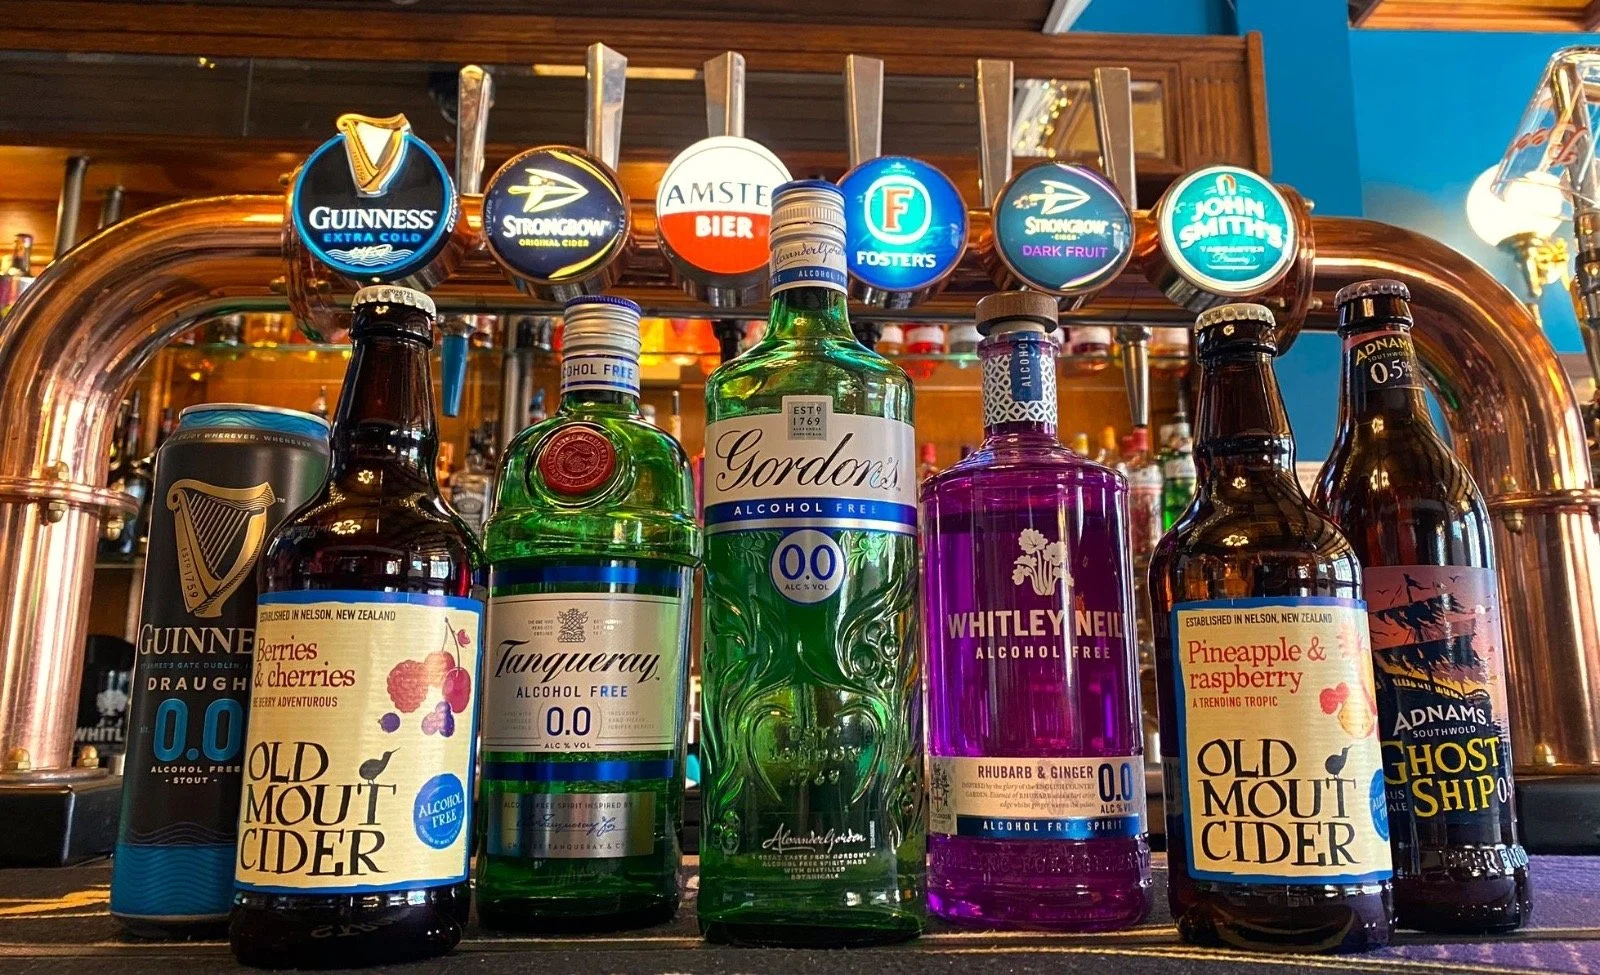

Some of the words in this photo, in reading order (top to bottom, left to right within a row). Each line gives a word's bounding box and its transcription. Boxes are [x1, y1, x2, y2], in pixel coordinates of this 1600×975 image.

[665, 181, 770, 208] AMSTE
[309, 207, 434, 230] GUINNESS
[883, 187, 914, 233] F
[1191, 195, 1265, 223] JOHN
[323, 232, 373, 243] EXTRA
[380, 232, 422, 243] COLD
[502, 215, 605, 238] STRONGBOW
[694, 215, 754, 239] BIER
[1024, 216, 1106, 236] STRONGBOW
[1179, 215, 1285, 249] SMITH'S
[518, 238, 560, 248] ORIGINAL
[562, 239, 589, 248] CIDER
[1022, 244, 1061, 258] DARK
[1065, 246, 1109, 258] FRUIT
[857, 251, 937, 268] FOSTER'S
[562, 363, 597, 378] COHOL
[603, 363, 633, 379] FREE
[1019, 335, 1033, 387] ALCOHOL
[1370, 359, 1413, 384] 0.5%
[793, 417, 820, 426] 1769
[715, 428, 900, 492] Gordon's
[733, 502, 823, 516] ALCOHOL
[836, 503, 876, 515] FREE
[778, 543, 836, 581] 0.0
[183, 571, 199, 599] 1759
[784, 583, 801, 591] ALC
[291, 609, 299, 620] IN
[300, 609, 334, 620] NELSON,
[335, 609, 356, 620] NEW
[357, 609, 396, 621] ZEALAND
[948, 609, 1065, 640] WHITLEY
[1075, 610, 1125, 638] NEIL
[1186, 614, 1232, 628] ESTABLISHED
[1234, 614, 1242, 625] IN
[1244, 614, 1280, 625] NELSON,
[1281, 613, 1300, 624] NEW
[1301, 613, 1333, 624] ZEALAND
[139, 623, 255, 655] GUINNE
[256, 634, 318, 662] Berries
[495, 639, 661, 685] Tanqueray
[976, 645, 1060, 660] ALCOHOL
[1071, 646, 1111, 659] FREE
[1187, 636, 1303, 668] Pineapple
[1307, 635, 1327, 662] &
[147, 676, 247, 691] DRAUGH
[254, 662, 264, 688] &
[267, 661, 356, 688] cherries
[1189, 664, 1304, 695] raspberry
[277, 696, 338, 708] ADVENTUROUS
[516, 685, 581, 698] ALCOHOL
[590, 685, 629, 698] FREE
[1192, 698, 1198, 709] A
[1197, 697, 1242, 709] TRENDING
[1244, 696, 1278, 707] TROPIC
[153, 697, 243, 762] 0.0
[546, 706, 592, 736] 0.0
[1392, 704, 1487, 737] ADNAMS
[1412, 725, 1476, 738] SOUTHWOLD
[73, 726, 124, 742] WHITL
[151, 765, 203, 773] ALCOHOL
[209, 765, 241, 773] FREE
[248, 741, 329, 784] OLD
[1197, 738, 1298, 780] OLD
[1381, 736, 1500, 786] GHOST
[173, 776, 209, 784] STOUT
[978, 765, 1032, 779] RHUBARB
[1037, 765, 1046, 779] &
[1050, 765, 1094, 779] GINGER
[1098, 762, 1134, 803] 0.0
[1003, 783, 1018, 791] glory
[1197, 777, 1357, 819] MOUT
[1411, 774, 1495, 818] SHIP
[244, 782, 397, 827] MOUT
[418, 791, 463, 819] ALCOHOL
[557, 801, 582, 809] SPIRIT
[585, 801, 621, 809] INSPIRED
[1100, 804, 1115, 814] ALC
[431, 807, 457, 829] FREE
[983, 819, 1039, 832] ALCOHOL
[1086, 820, 1122, 831] SPIRIT
[240, 827, 389, 877] CIDER
[1201, 820, 1362, 867] CIDER
